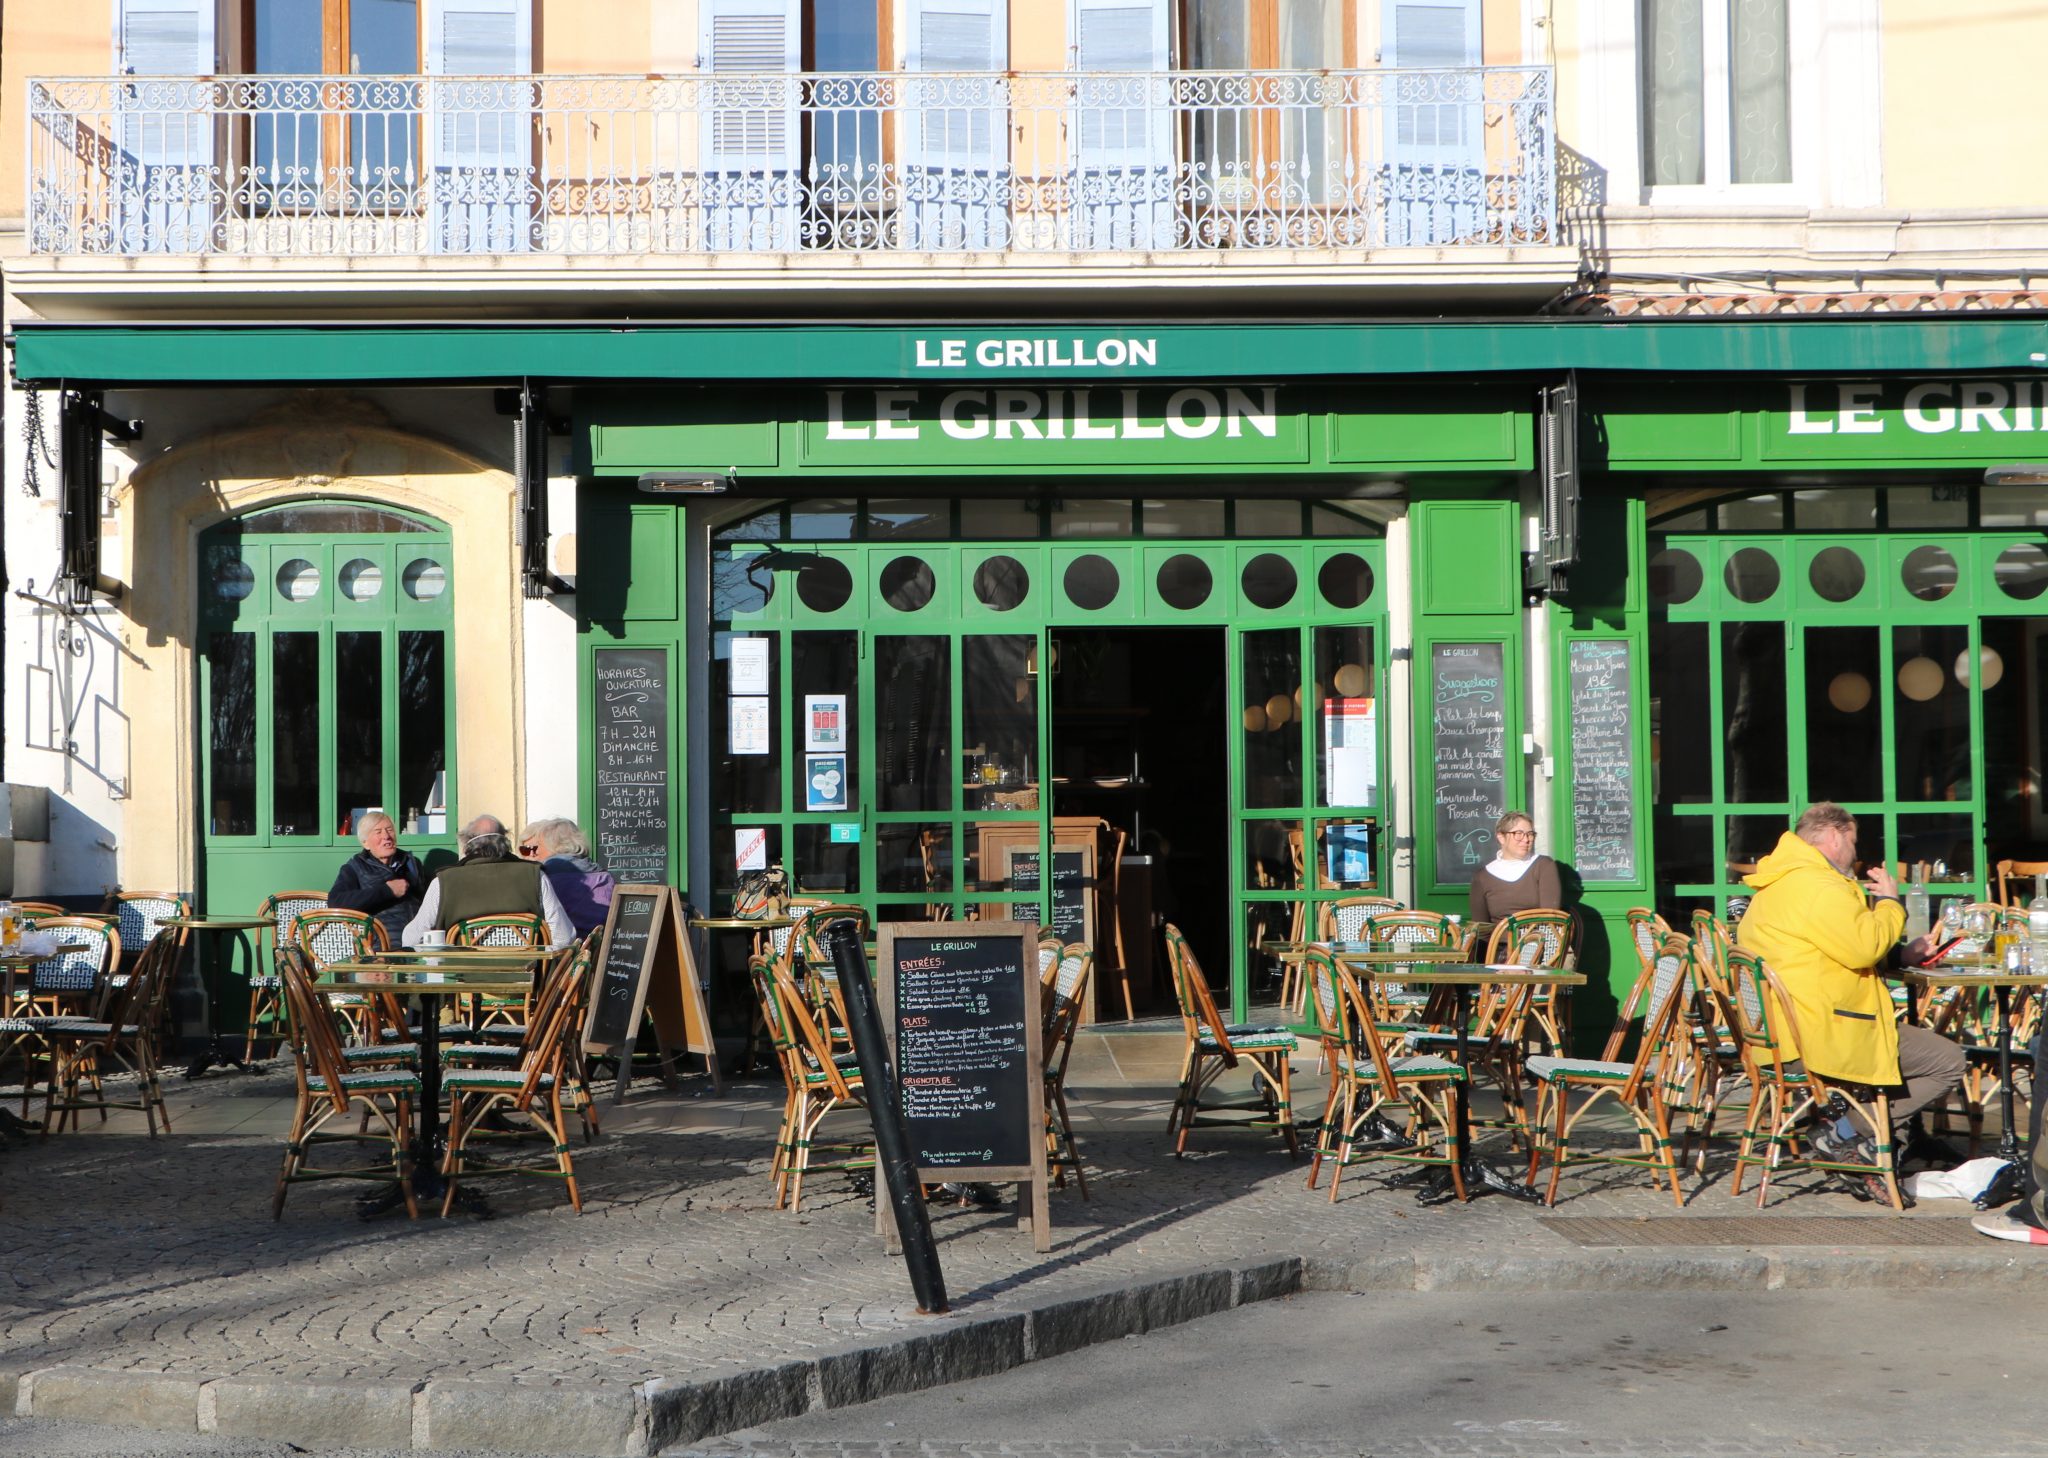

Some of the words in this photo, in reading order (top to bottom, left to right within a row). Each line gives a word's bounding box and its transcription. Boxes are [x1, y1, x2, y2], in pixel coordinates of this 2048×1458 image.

[915, 338, 967, 367] LE
[975, 338, 1157, 367] GRILLON
[825, 389, 920, 440] LE
[939, 387, 1277, 440] GRILLON
[1787, 384, 1884, 434] LE
[1903, 381, 2048, 433] GRI
[597, 667, 646, 680] HORAIRES
[606, 679, 661, 691] OUVERTURE
[611, 705, 639, 718] BAR
[598, 769, 666, 784] RESTAURANT
[930, 943, 942, 952] LE
[943, 942, 977, 952] GRILLON
